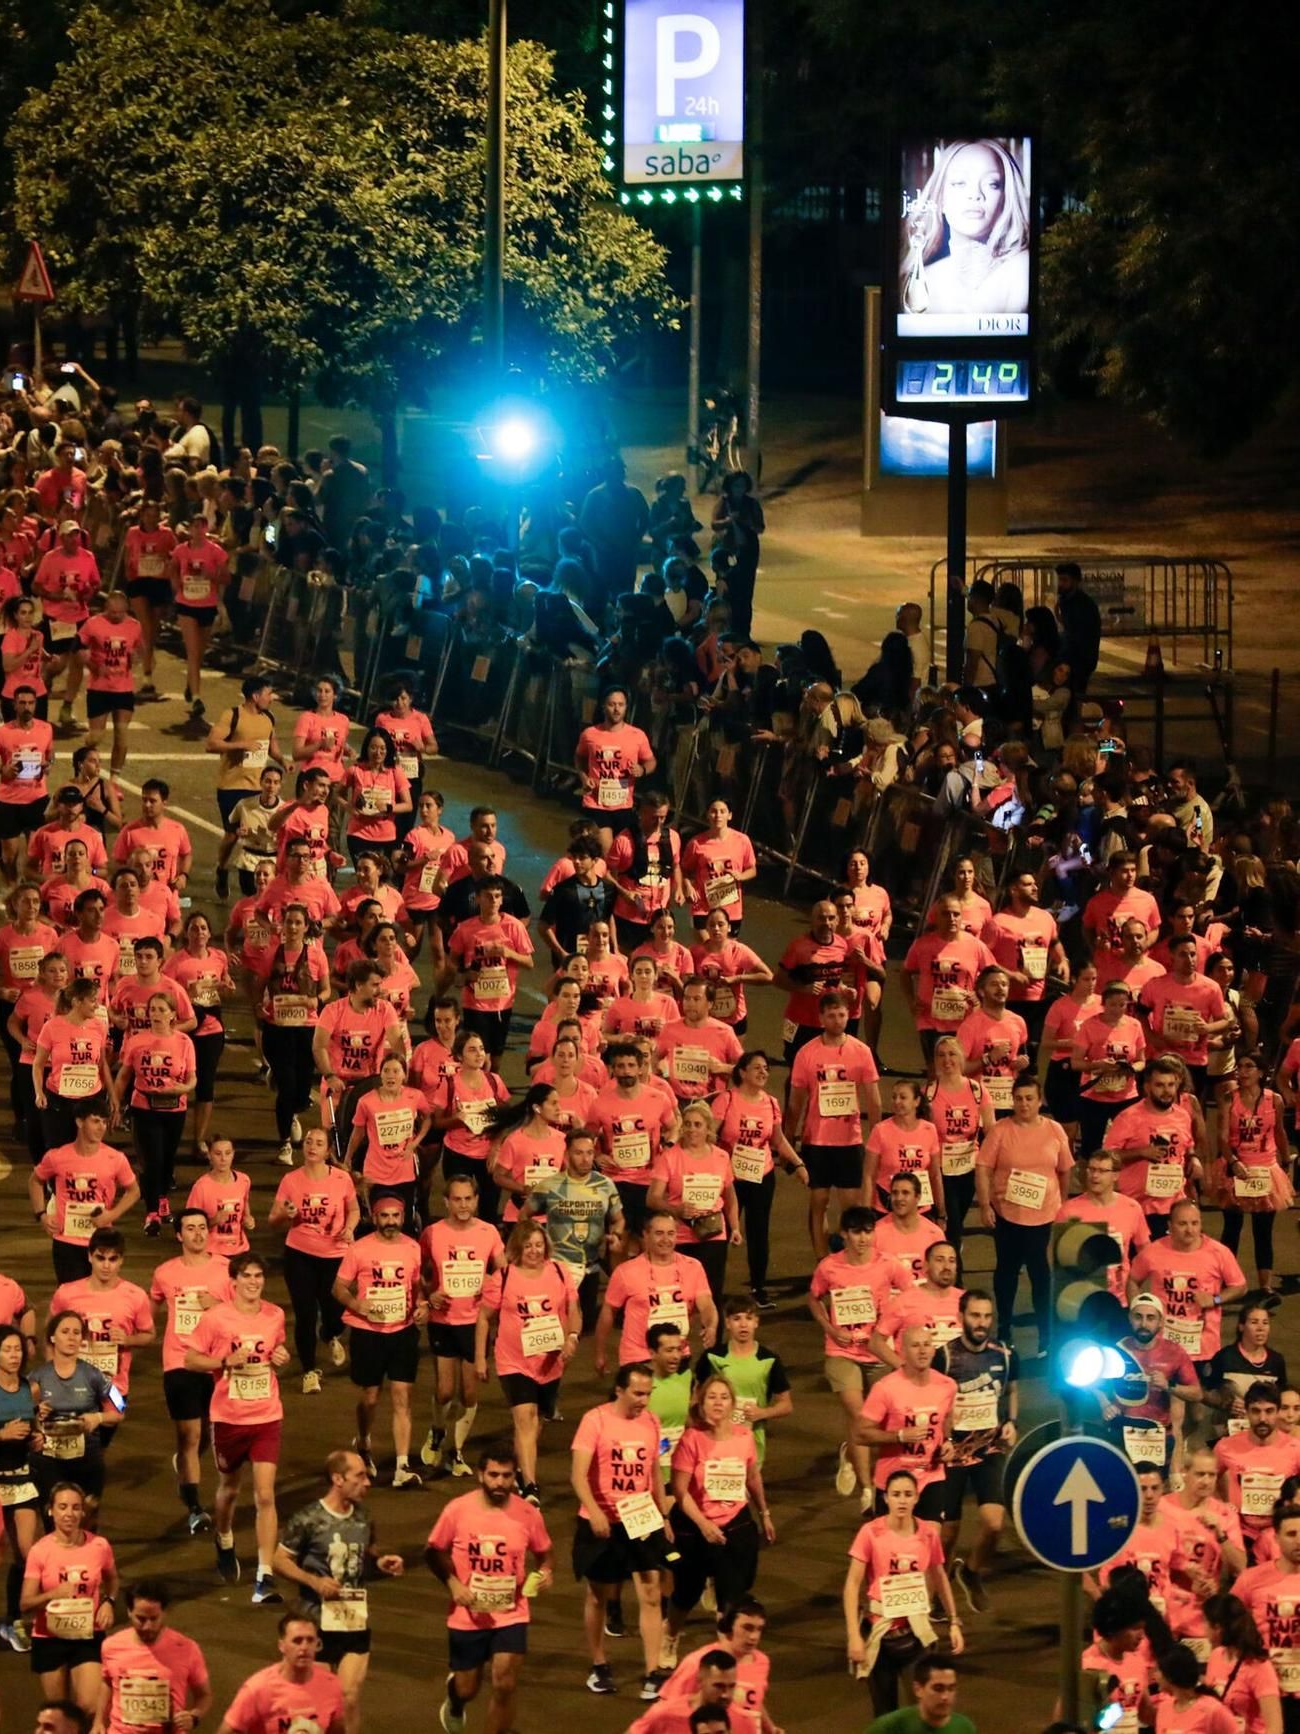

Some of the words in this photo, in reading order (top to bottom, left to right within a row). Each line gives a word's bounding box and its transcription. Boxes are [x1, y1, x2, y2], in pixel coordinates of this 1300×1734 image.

[657, 14, 720, 116] P
[684, 96, 719, 116] 24h
[978, 319, 1021, 331] DIOR
[600, 770, 614, 779] NA
[71, 1053, 92, 1061] TUR
[341, 1048, 371, 1059] TUR
[342, 1059, 362, 1070] NA
[676, 1062, 707, 1075] 15940
[141, 1067, 171, 1078] TUR
[62, 1077, 95, 1089] 17656
[145, 1078, 166, 1087] NA
[826, 1097, 849, 1108] 1697
[469, 1115, 494, 1127] 179
[946, 1119, 969, 1127] TUR
[380, 1124, 412, 1138] 22749
[740, 1129, 761, 1138] TUR
[946, 1127, 962, 1135] NA
[618, 1147, 645, 1159] 8511
[735, 1159, 760, 1173] 3946
[1243, 1181, 1263, 1190] 749
[66, 1191, 95, 1202] TUR
[688, 1191, 715, 1201] 2694
[1012, 1186, 1039, 1200] 3950
[302, 1208, 326, 1217] TUR
[71, 1217, 92, 1229] 182
[446, 1277, 481, 1288] 16169
[1166, 1292, 1195, 1302] TUR
[837, 1303, 873, 1315] 21903
[1167, 1304, 1186, 1316] NA
[178, 1314, 202, 1325] 181
[529, 1333, 557, 1345] 2664
[233, 1378, 268, 1390] 18159
[612, 1464, 644, 1476] TUR
[612, 1478, 636, 1490] NA
[469, 1558, 503, 1572] TUR
[884, 1591, 925, 1606] 22920
[54, 1616, 87, 1629] 7762
[124, 1699, 166, 1712] 10343
